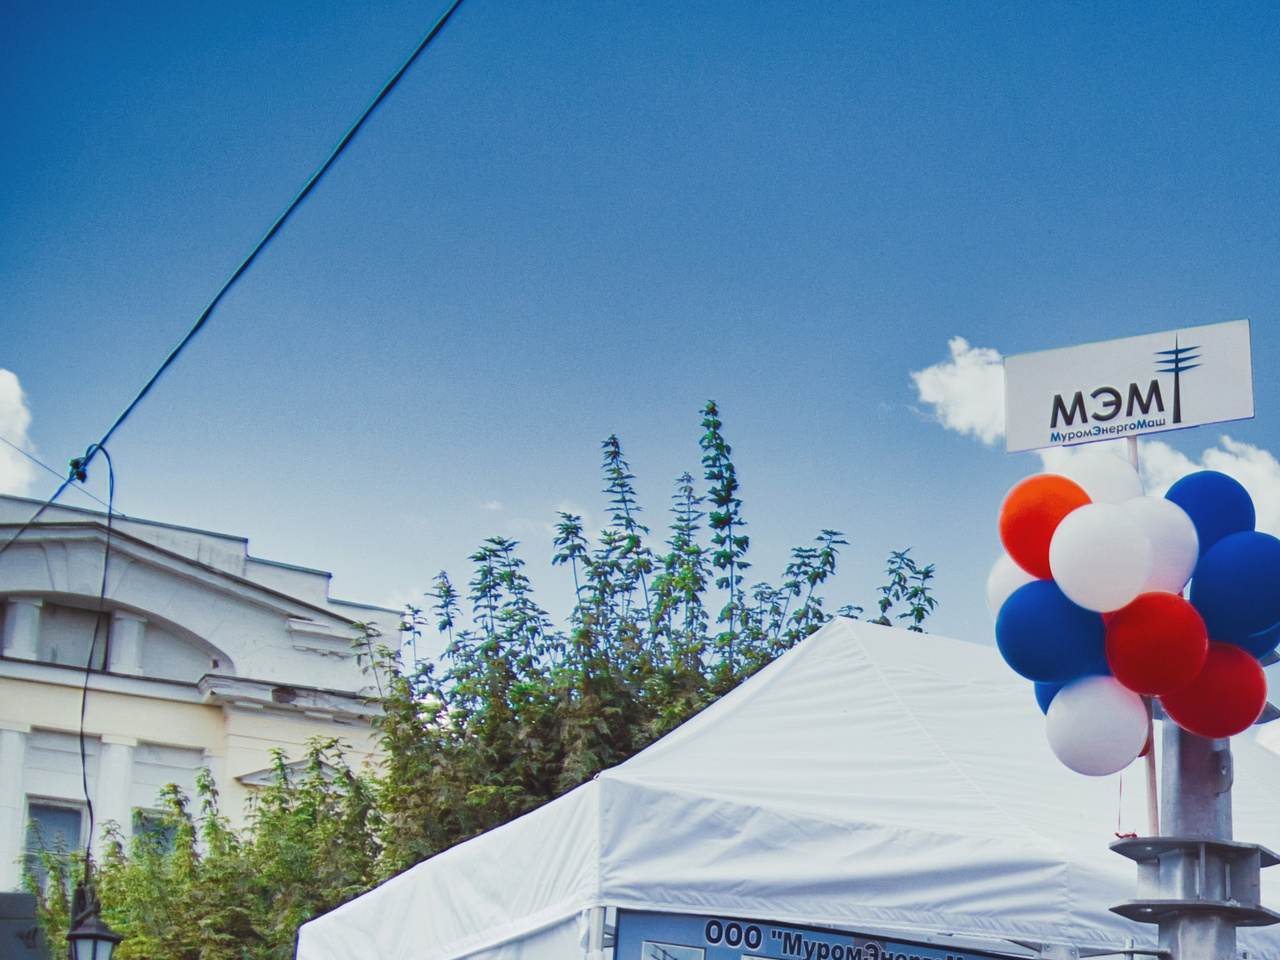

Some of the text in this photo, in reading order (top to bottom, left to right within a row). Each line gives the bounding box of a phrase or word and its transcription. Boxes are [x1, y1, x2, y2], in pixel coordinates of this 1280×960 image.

[1050, 379, 1165, 428] МЭМ
[1051, 417, 1166, 442] МуромЭнергоМаш
[705, 920, 762, 949] ООО
